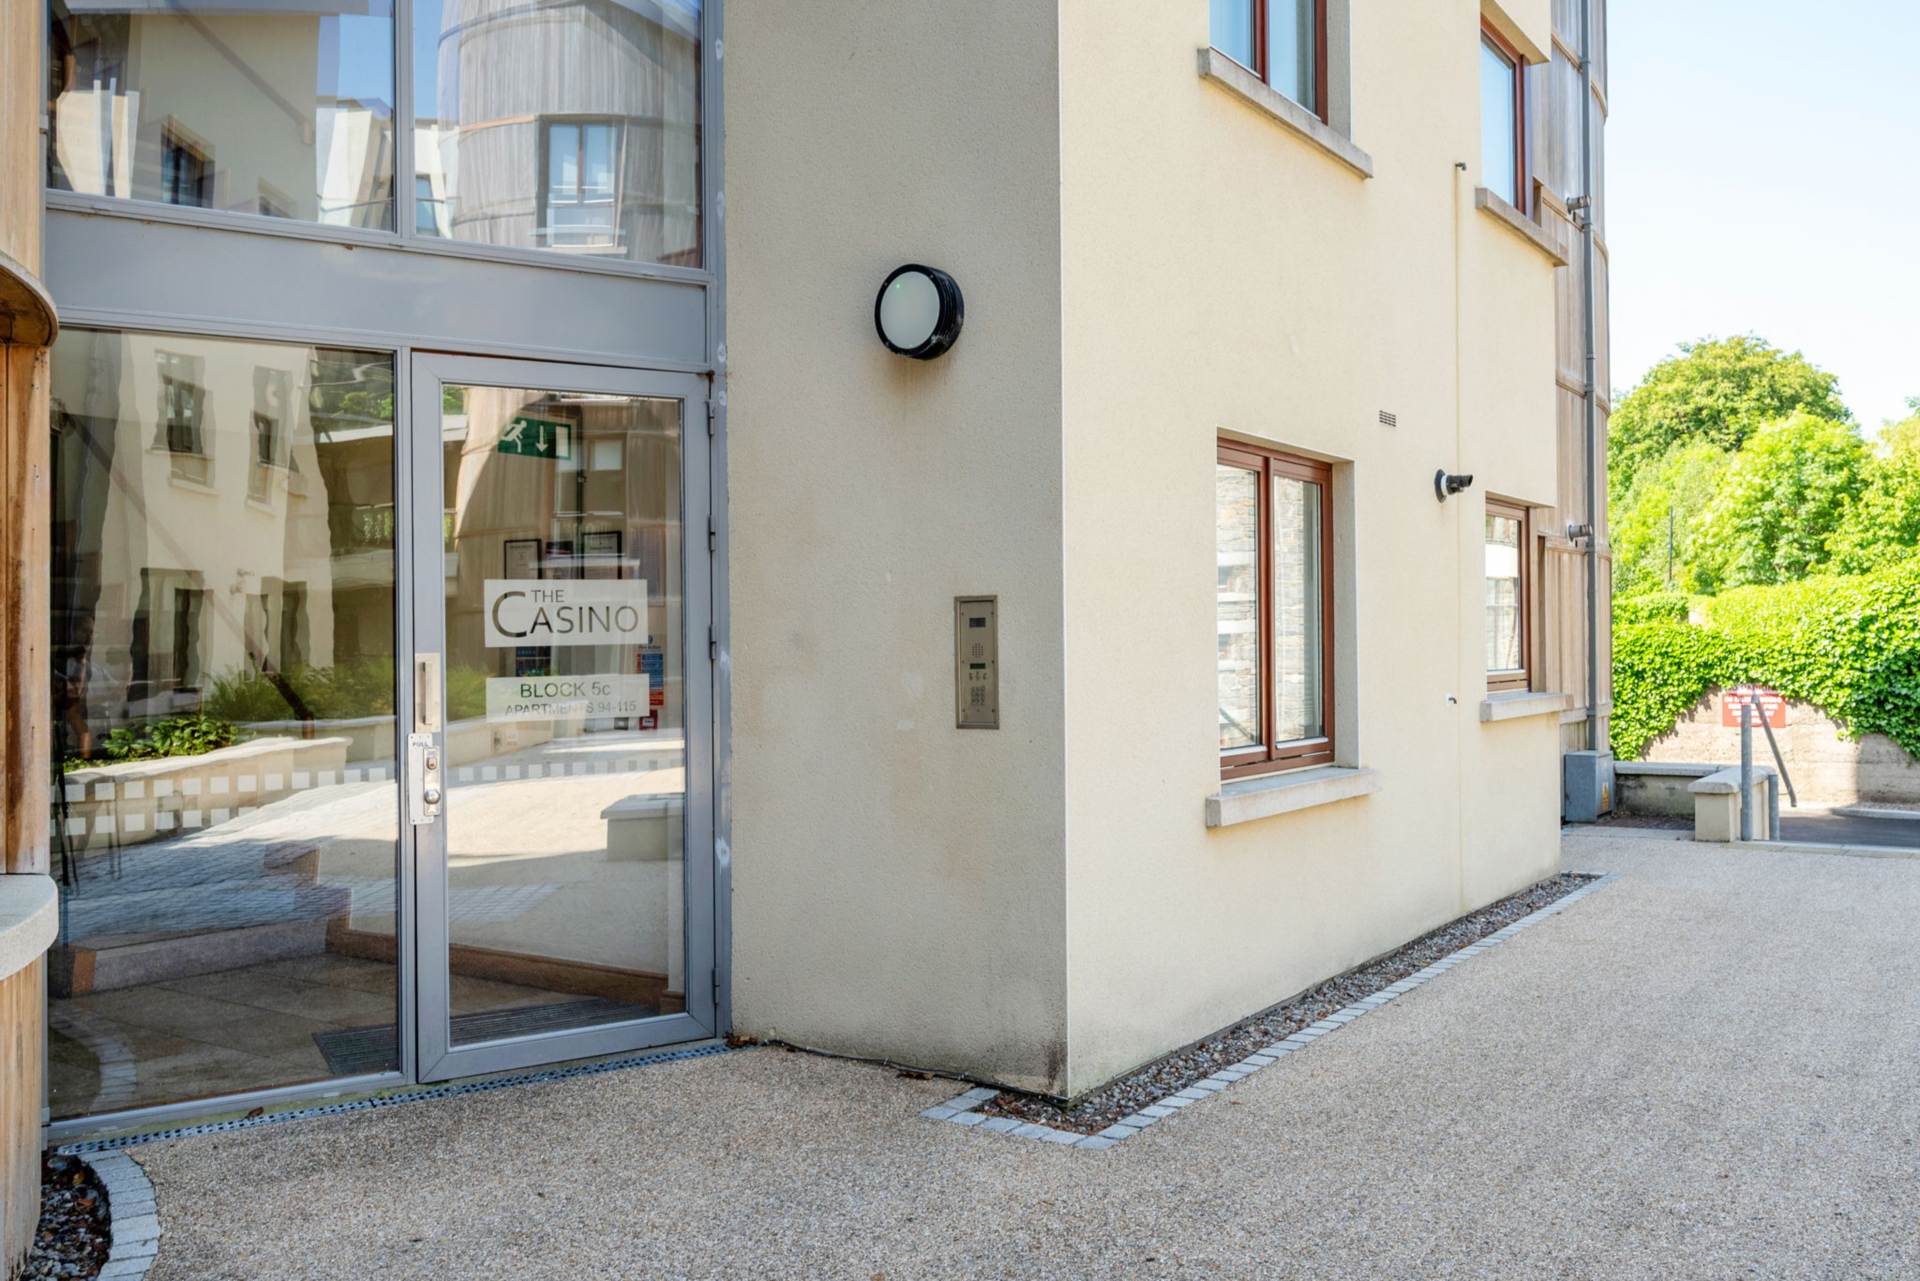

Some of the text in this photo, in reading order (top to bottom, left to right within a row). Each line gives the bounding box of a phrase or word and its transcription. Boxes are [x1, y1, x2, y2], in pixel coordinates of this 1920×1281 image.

[531, 589, 565, 603] THE
[492, 591, 638, 638] CASINO
[520, 681, 611, 698] BLOCK 5c
[598, 700, 637, 713] 94-115
